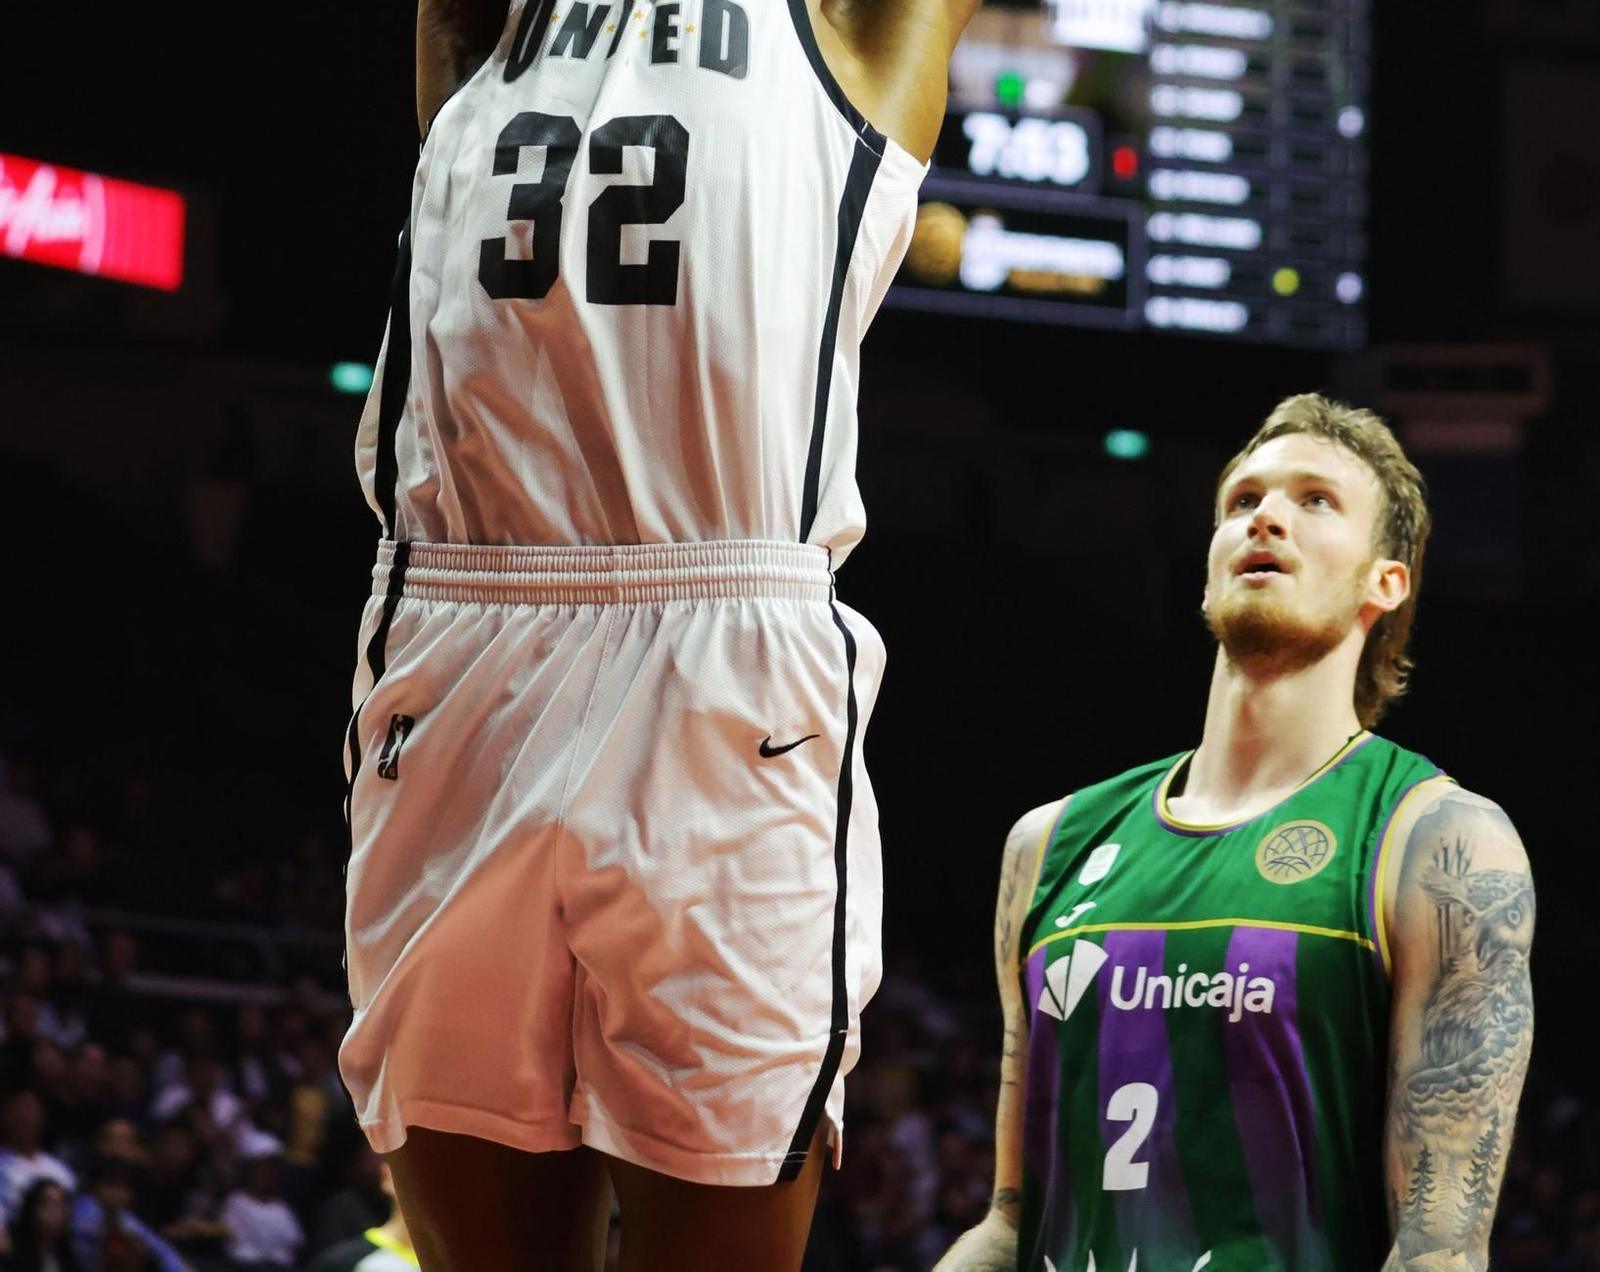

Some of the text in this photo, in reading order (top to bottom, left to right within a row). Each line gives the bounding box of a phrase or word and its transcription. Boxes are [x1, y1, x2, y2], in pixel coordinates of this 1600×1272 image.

[478, 111, 690, 306] 32
[1110, 962, 1276, 1023] Unicaja
[1102, 1081, 1159, 1192] 2
